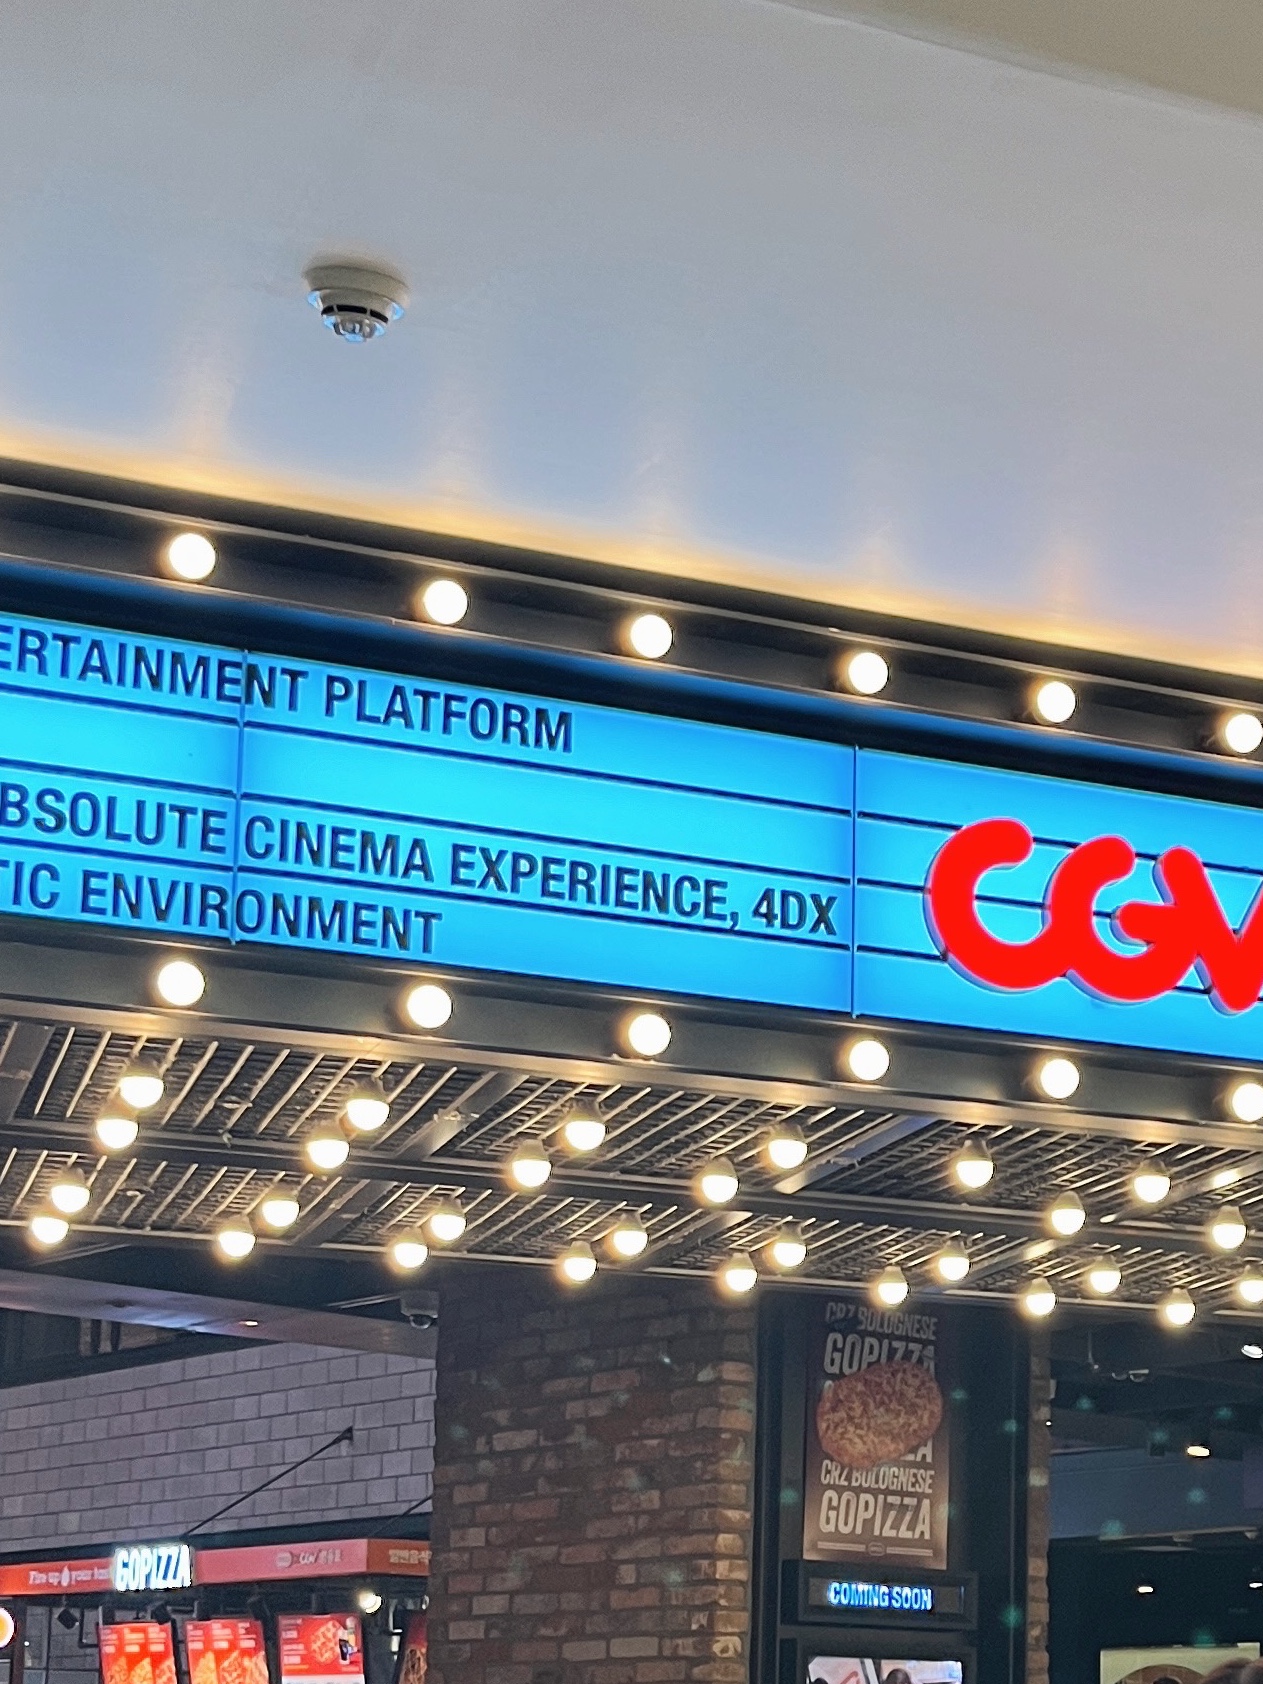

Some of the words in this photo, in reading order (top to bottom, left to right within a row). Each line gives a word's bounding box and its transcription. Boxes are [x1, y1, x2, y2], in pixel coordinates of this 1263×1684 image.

[325, 673, 574, 754] PLATFORM
[0, 781, 228, 855] BSOLUTE
[244, 814, 434, 885] CINEMA
[450, 842, 741, 933] EXPERIENCE,
[753, 886, 839, 939] 4DX
[81, 868, 444, 955] ENVIRONMENT
[851, 1466, 935, 1494] BOLOGNESE
[818, 1489, 932, 1541] GOPIZZA
[114, 1544, 192, 1592] GOPIZZA
[828, 1581, 889, 1609] COMING
[890, 1585, 933, 1612] SOON
